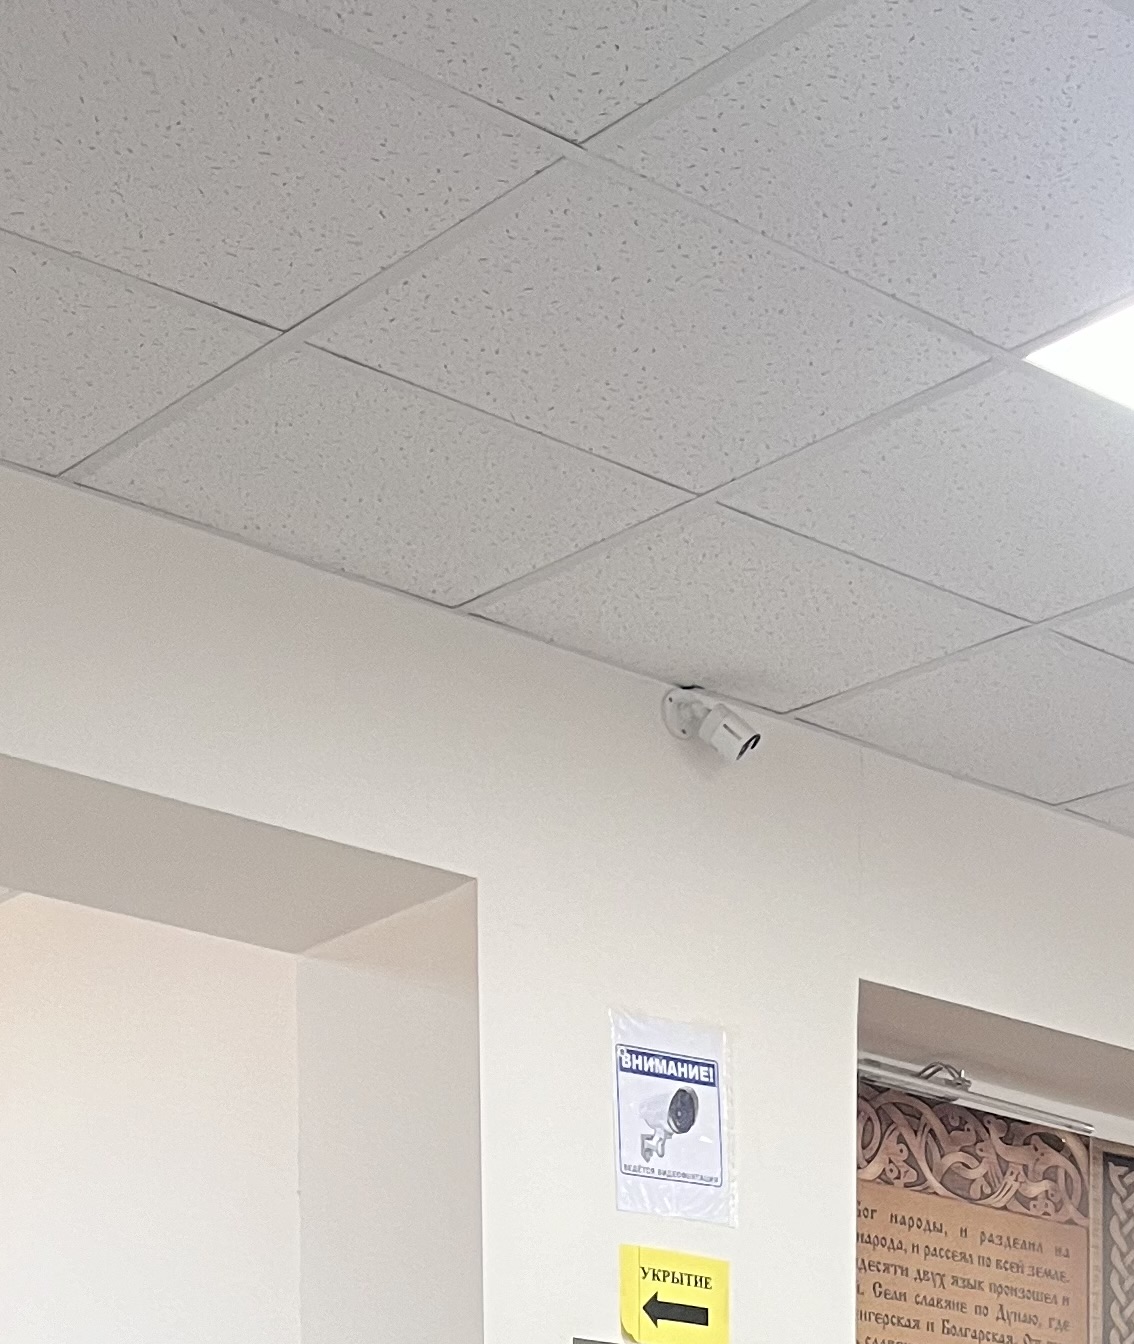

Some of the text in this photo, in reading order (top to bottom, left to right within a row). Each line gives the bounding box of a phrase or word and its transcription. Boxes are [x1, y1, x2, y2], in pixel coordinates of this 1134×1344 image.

[622, 1053, 714, 1083] ВНИМАНИЕ!
[890, 1212, 947, 1237] народы,
[980, 1231, 1043, 1253] разделил
[1055, 1246, 1070, 1258] на
[912, 1243, 919, 1254] и
[924, 1246, 973, 1265] рассеял
[978, 1255, 991, 1267] по
[996, 1259, 1024, 1274] всей
[640, 1266, 712, 1289] УКРЫТИЕ
[857, 1258, 1057, 1305] десяти двух язык произошел
[872, 1281, 907, 1303] Сели
[915, 1293, 967, 1314] славяне
[975, 1304, 988, 1316] по
[996, 1304, 1041, 1328] Дунаю,
[1049, 1317, 1070, 1333] где
[857, 1310, 920, 1330] нгерская
[927, 1321, 934, 1332] и
[941, 1319, 1017, 1344] Болгарская.
